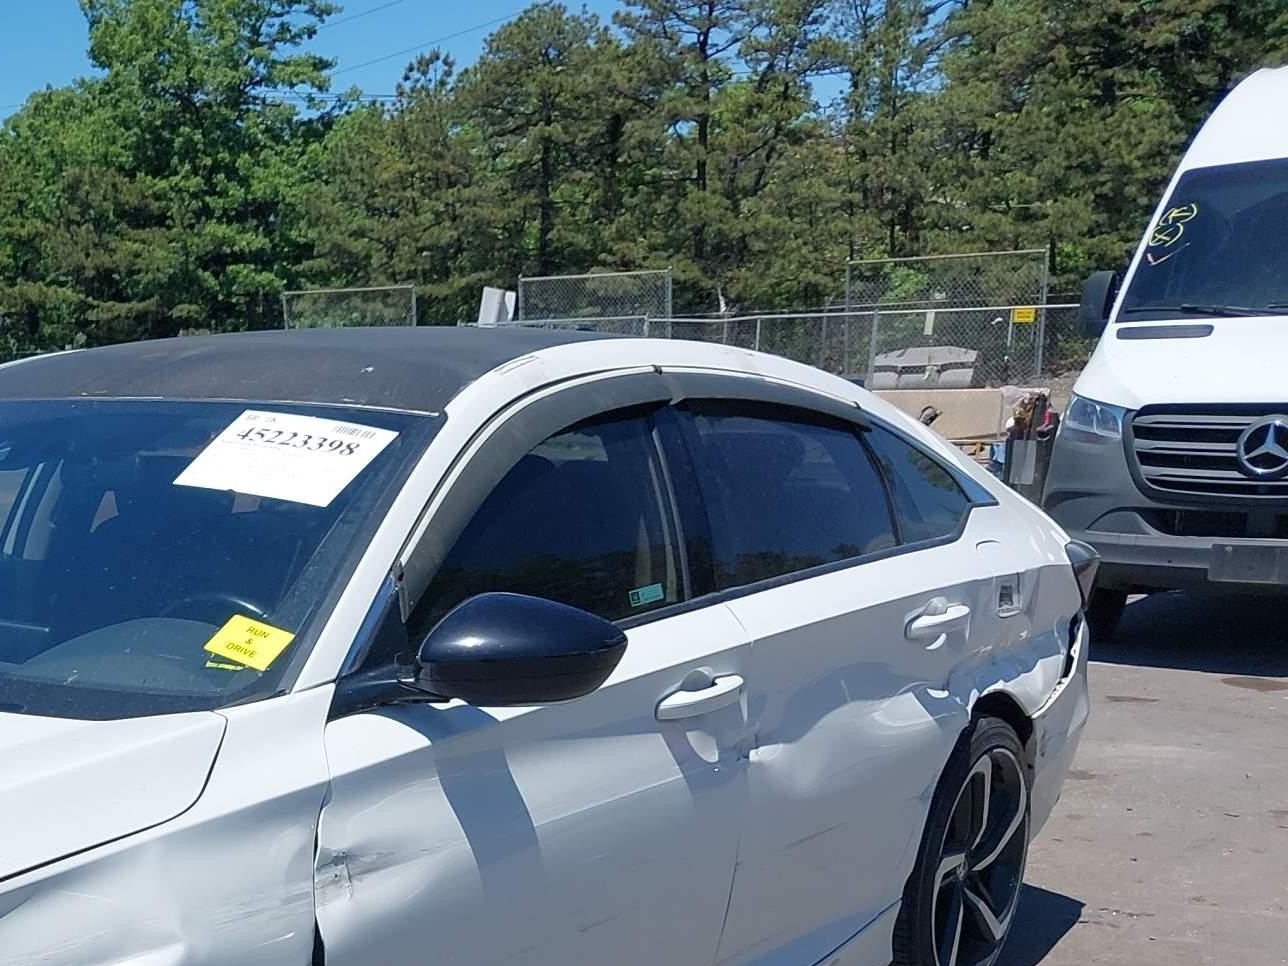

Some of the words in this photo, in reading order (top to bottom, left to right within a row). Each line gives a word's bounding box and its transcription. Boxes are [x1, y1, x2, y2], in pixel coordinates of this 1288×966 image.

[237, 427, 360, 455] 45223398
[246, 626, 270, 638] RUN
[226, 643, 257, 657] DRIVE
